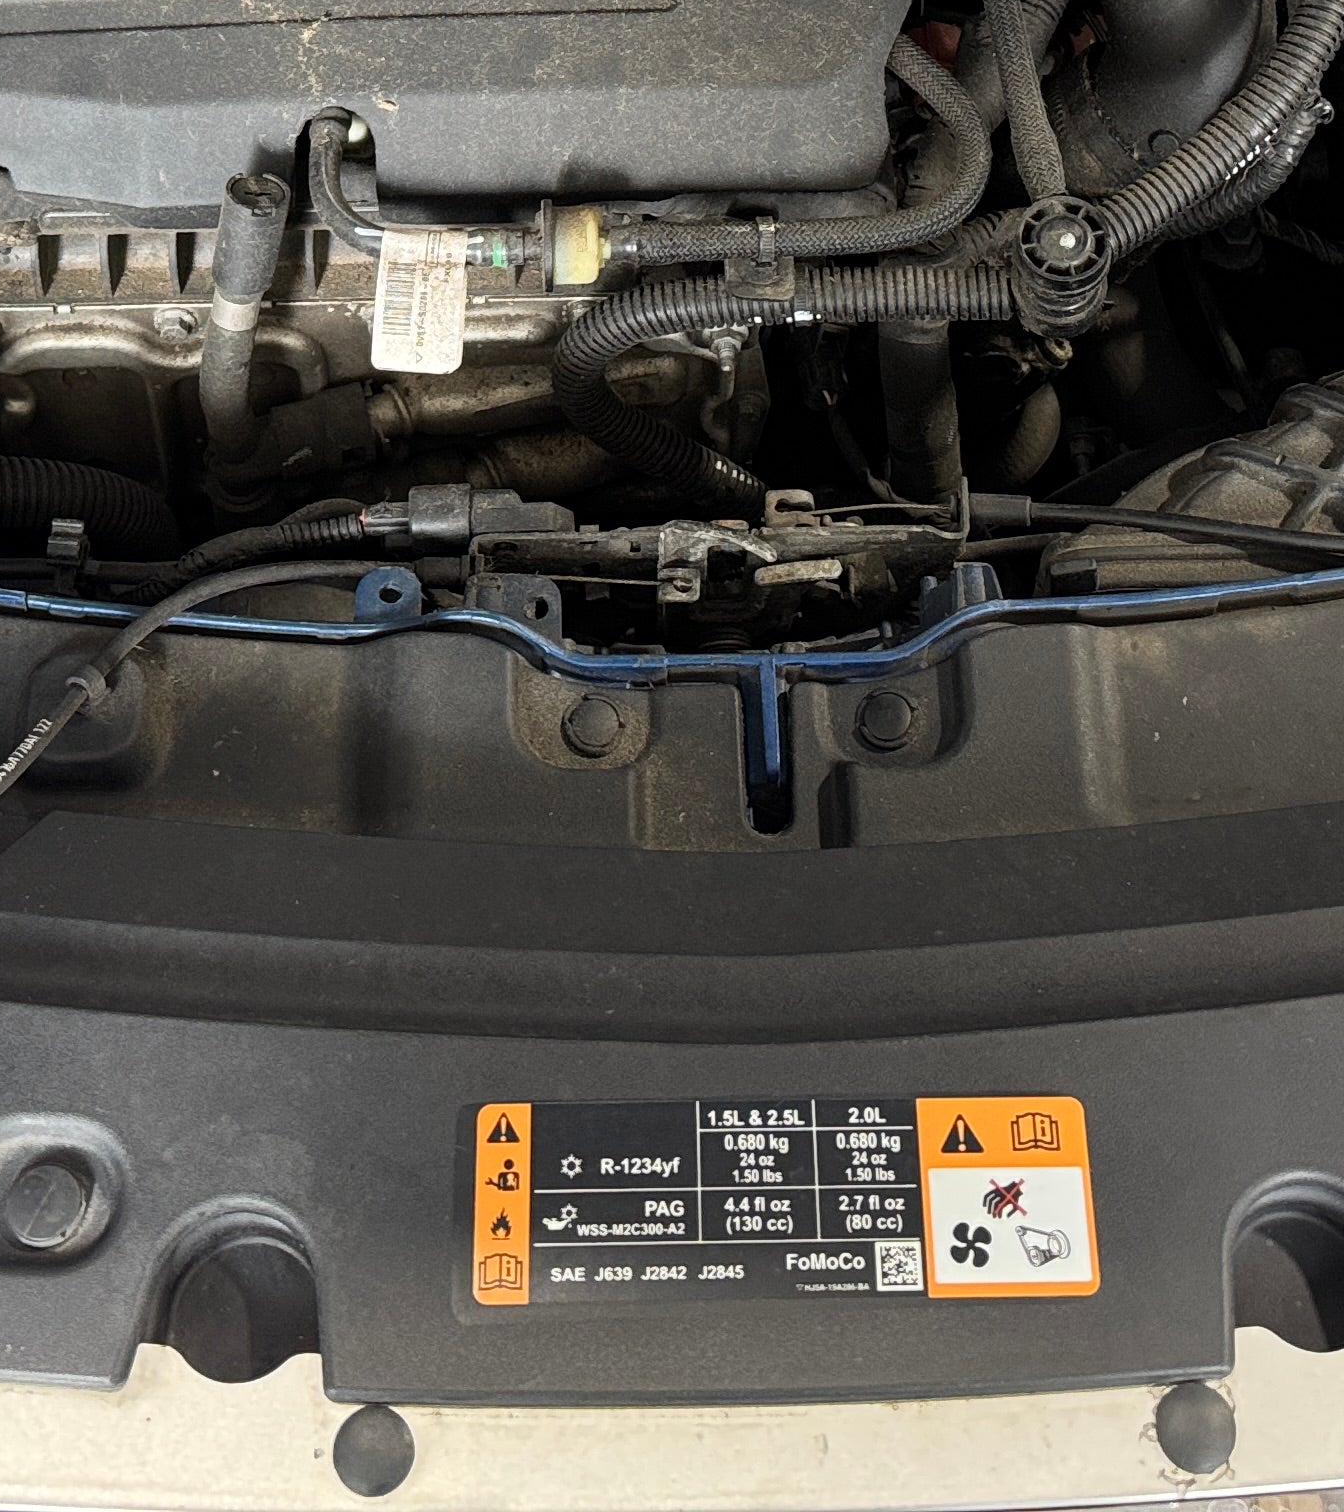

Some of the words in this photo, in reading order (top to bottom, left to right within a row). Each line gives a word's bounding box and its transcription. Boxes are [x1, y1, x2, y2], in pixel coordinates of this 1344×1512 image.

[707, 1110, 745, 1126] 1.5L
[748, 1110, 762, 1126] &
[767, 1109, 805, 1125] 2.5L
[848, 1107, 886, 1124] 2.0L
[724, 1134, 765, 1151] 0.680
[767, 1134, 789, 1153] kg
[836, 1133, 877, 1150] 0.680
[881, 1133, 901, 1152] kg
[600, 1157, 681, 1177] R-1234yf
[739, 1153, 756, 1167] 24
[758, 1155, 775, 1167] oz
[852, 1152, 868, 1165] 24
[870, 1154, 887, 1165] oz
[732, 1169, 759, 1183] 1.50
[762, 1169, 783, 1183] lbs
[845, 1168, 872, 1182] 1.50
[875, 1168, 895, 1182] lbs
[644, 1200, 685, 1217] PAG
[724, 1197, 749, 1213] 4.4
[754, 1197, 766, 1213] fl
[769, 1199, 791, 1212] oz
[838, 1196, 864, 1212] 2.7
[868, 1196, 880, 1211] fl
[883, 1199, 905, 1211] oz
[577, 1223, 685, 1237] WSS-M2C300-A2
[726, 1215, 758, 1234] (130
[762, 1214, 794, 1234] cc)
[846, 1215, 871, 1233] (80
[874, 1214, 903, 1233] cc)
[785, 1252, 866, 1271] FoMoCo
[550, 1267, 585, 1282] SAE
[594, 1266, 633, 1282] J639
[641, 1266, 687, 1281] J2842
[698, 1265, 744, 1280] J2845
